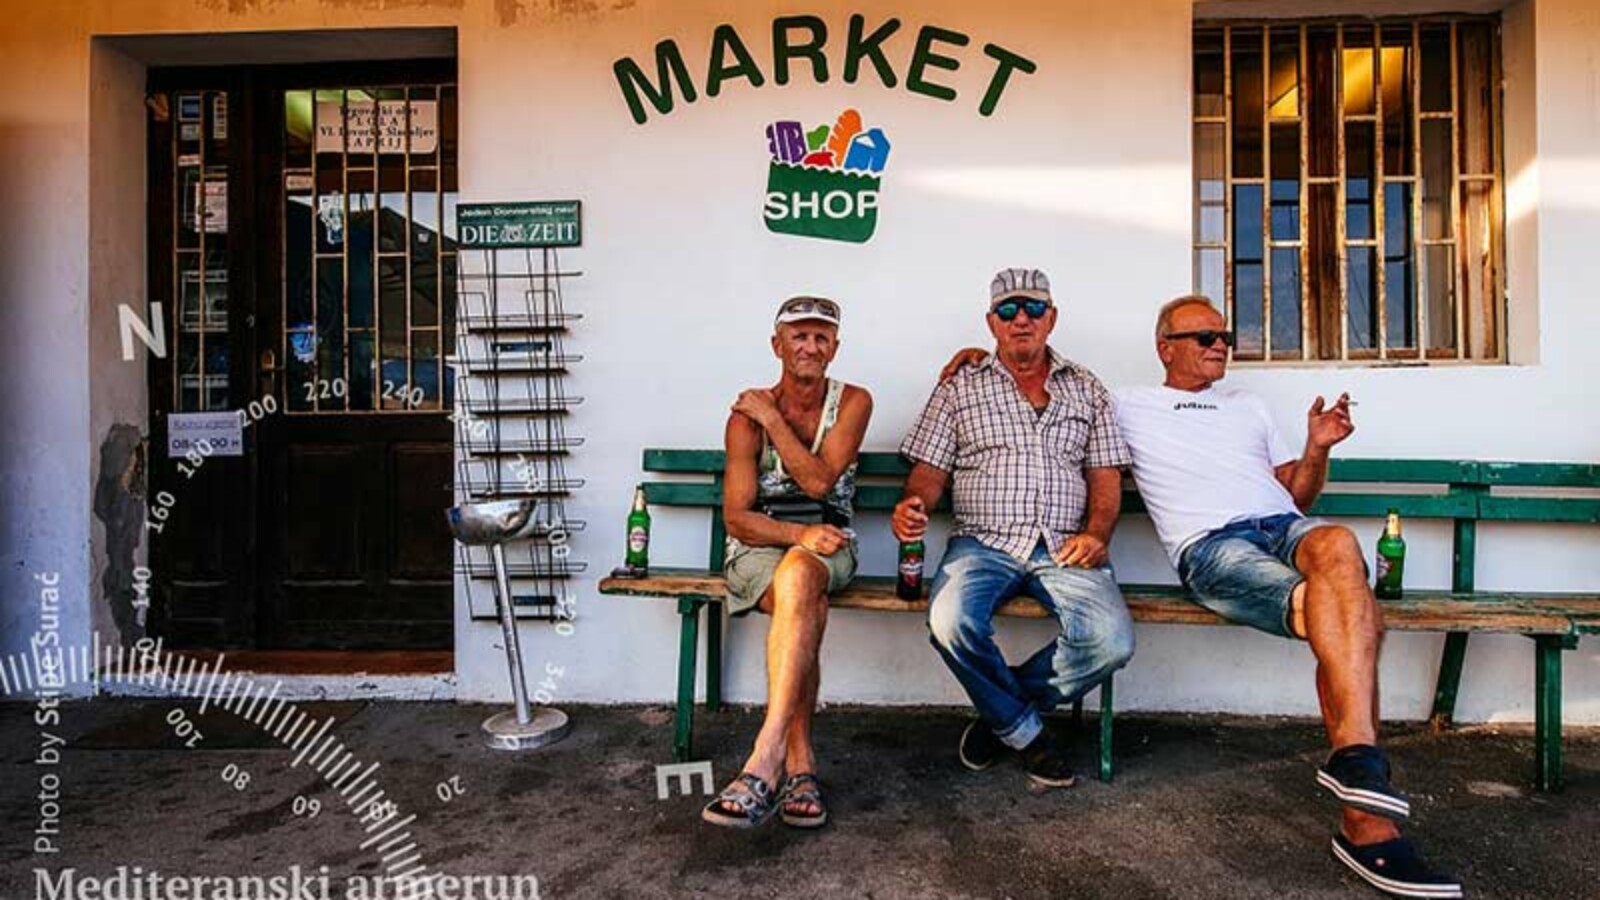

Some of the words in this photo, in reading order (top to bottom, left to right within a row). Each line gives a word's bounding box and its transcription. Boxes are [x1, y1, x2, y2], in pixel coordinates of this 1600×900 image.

[613, 14, 1037, 125] MARKET
[494, 207, 553, 215] Donnerstag
[765, 190, 878, 220] SHOP
[461, 225, 499, 244] DIE
[528, 222, 576, 242] ZEIT
